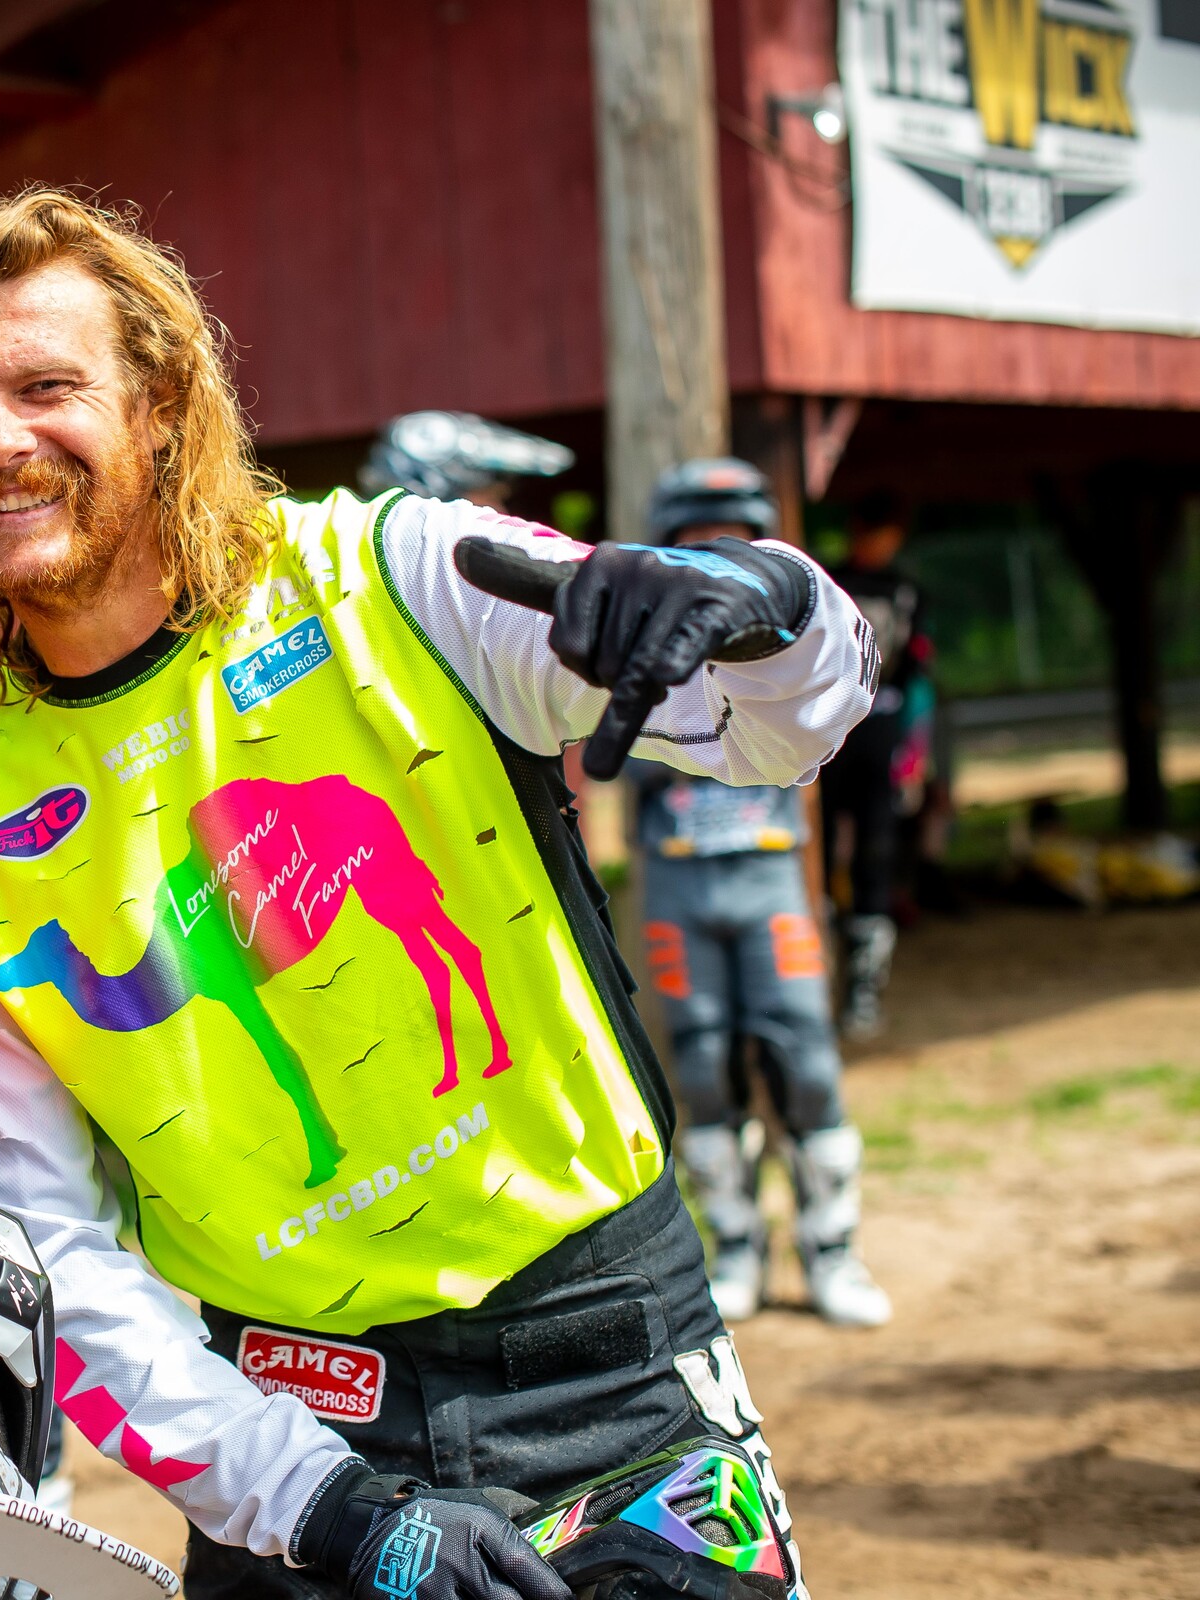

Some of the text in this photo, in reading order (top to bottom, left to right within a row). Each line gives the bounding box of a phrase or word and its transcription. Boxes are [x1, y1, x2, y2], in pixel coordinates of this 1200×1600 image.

[230, 628, 324, 695] CAMEL
[238, 643, 328, 707] SMOKERCROSS
[101, 732, 148, 772] WE
[117, 748, 168, 785] MOTO
[167, 807, 280, 939] Lonesome
[227, 823, 309, 949] Camel
[292, 845, 375, 940] Farm
[254, 1102, 491, 1262] LCFCBD.COM
[244, 1344, 375, 1397] CAMEL
[55, 1518, 88, 1543] FOX
[94, 1534, 152, 1575] MOTO-X
